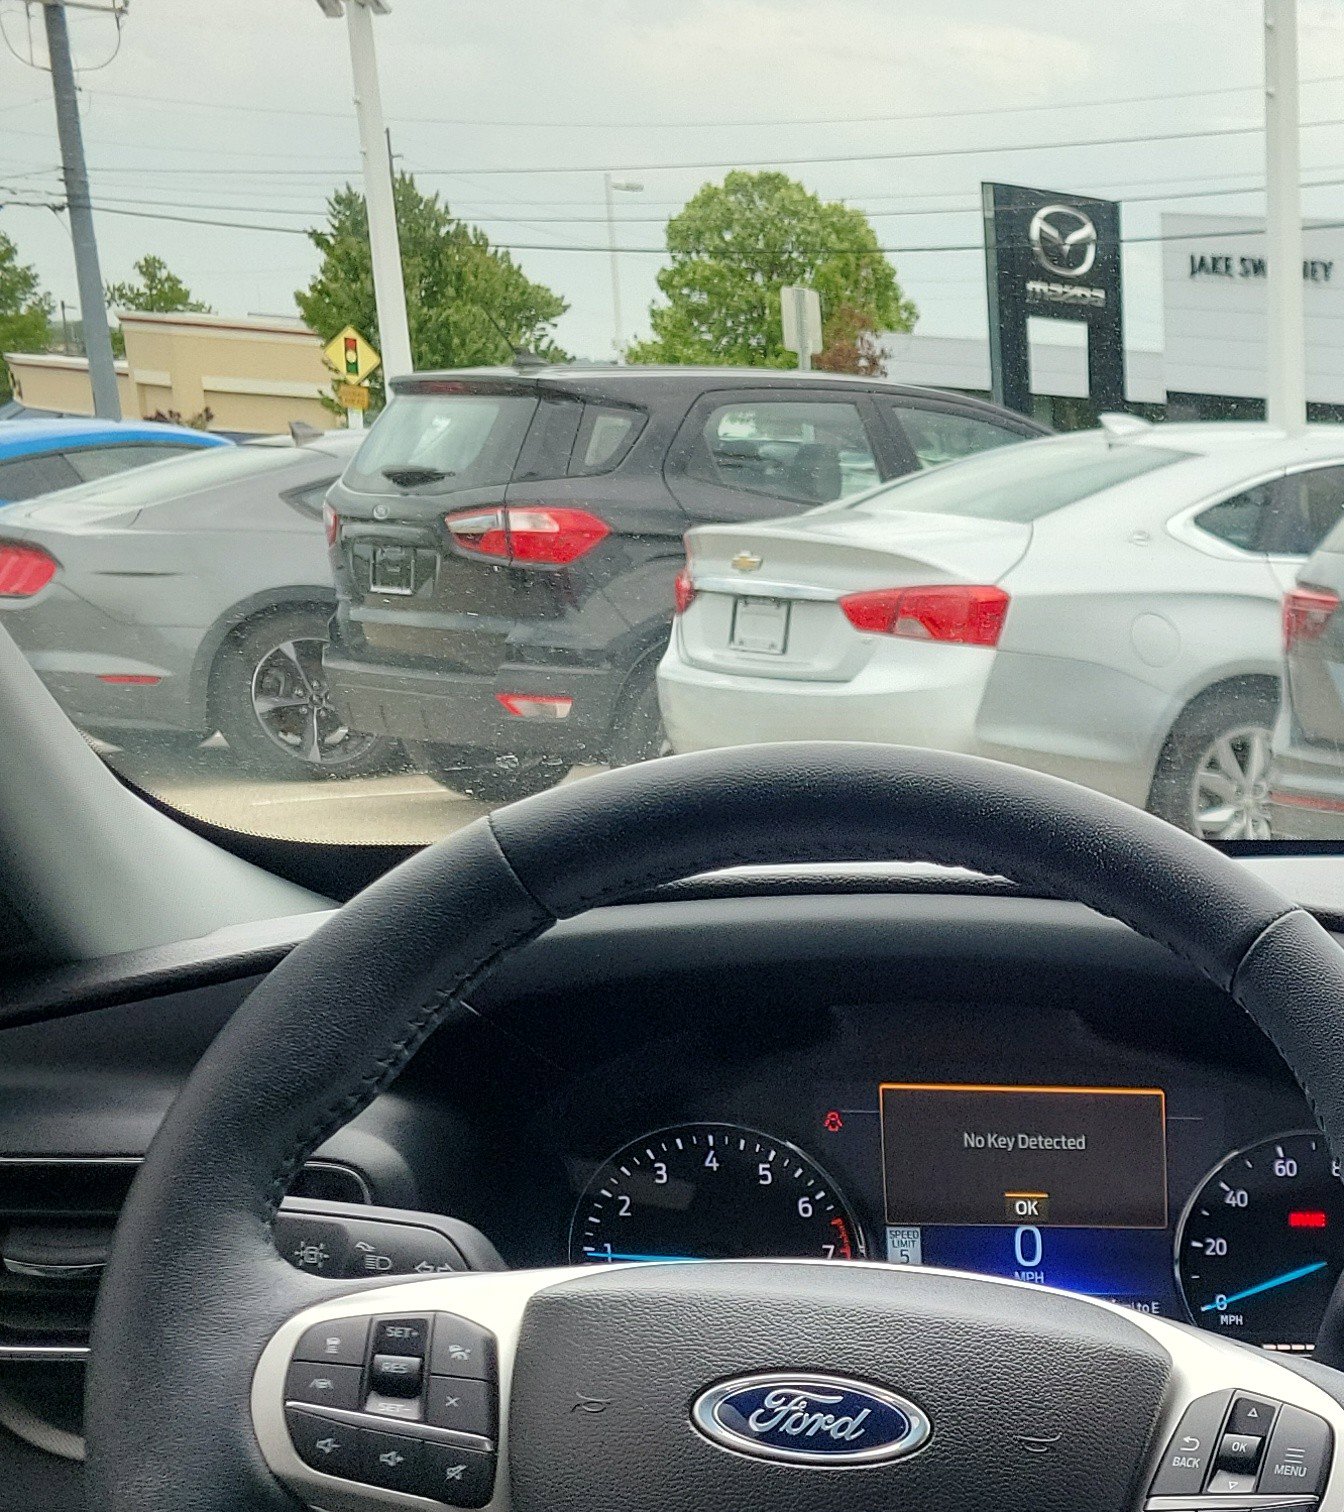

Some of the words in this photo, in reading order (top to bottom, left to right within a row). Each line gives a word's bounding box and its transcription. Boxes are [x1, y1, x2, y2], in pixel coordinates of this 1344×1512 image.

[964, 1133, 984, 1148] No
[987, 1134, 1015, 1151] Key
[1018, 1135, 1086, 1150] Detected
[705, 1151, 719, 1171] 4
[1274, 1159, 1298, 1177] 60
[654, 1163, 667, 1184] 3
[758, 1164, 772, 1185] 5
[618, 1196, 632, 1217] 2
[798, 1197, 813, 1218] 6
[1015, 1200, 1039, 1216] OK
[1224, 1190, 1248, 1208] 40
[889, 1229, 920, 1240] SPEED
[891, 1238, 917, 1249] LIMIT
[821, 1244, 835, 1260] 7
[1014, 1225, 1042, 1267] 0
[1204, 1238, 1228, 1256] 20
[1220, 1314, 1244, 1326] MPH
[749, 1387, 872, 1441] Ford
[1231, 1441, 1248, 1453] OK
[1172, 1456, 1201, 1469] BACK
[1274, 1464, 1308, 1478] MENU
